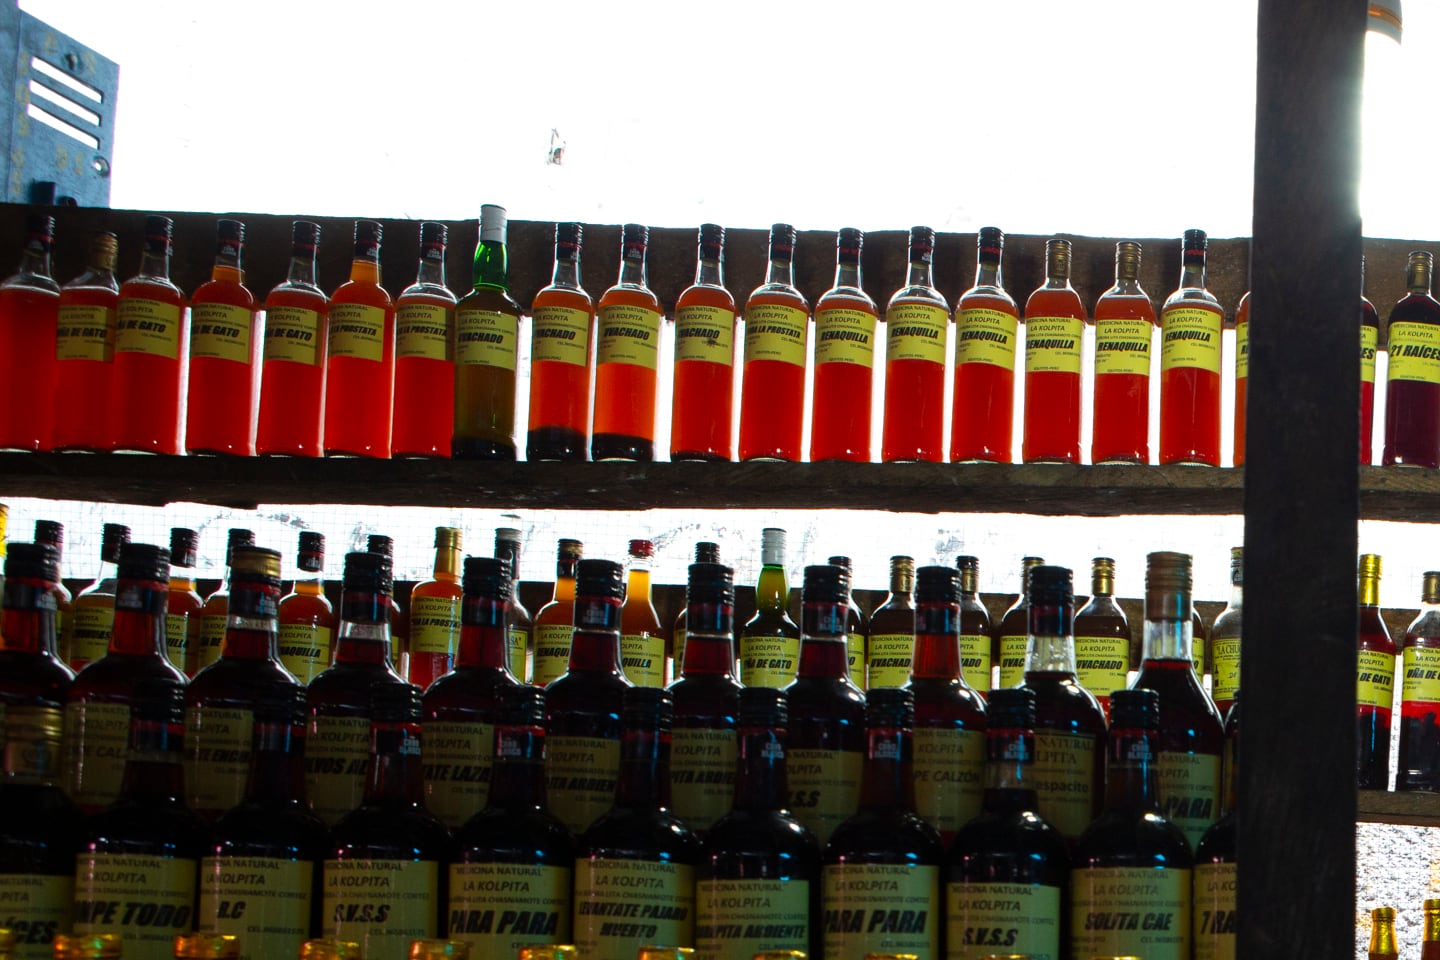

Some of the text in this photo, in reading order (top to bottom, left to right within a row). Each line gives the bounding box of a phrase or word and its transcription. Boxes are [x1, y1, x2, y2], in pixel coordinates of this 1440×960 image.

[139, 321, 166, 332] GATO
[213, 326, 239, 337] GATO
[766, 326, 801, 338] PROSTATA
[286, 329, 312, 341] GATO
[675, 746, 721, 756] KOLPITA
[94, 872, 146, 883] KOLPITA
[339, 877, 389, 886] KOLPITA
[612, 877, 664, 888] KOLPITA
[477, 882, 529, 892] KOLPITA
[851, 881, 898, 891] KOLPITA
[1109, 886, 1158, 895] KOLPITA
[721, 898, 771, 908] KOLPITA
[971, 902, 1020, 911] KOLPITA
[121, 903, 190, 928] TODO
[497, 911, 559, 935] PARA
[868, 910, 926, 933] PARA
[1085, 913, 1173, 930] SOLITA CAE
[600, 923, 657, 938] MUERTO
[744, 925, 805, 938] ARDIENTE
